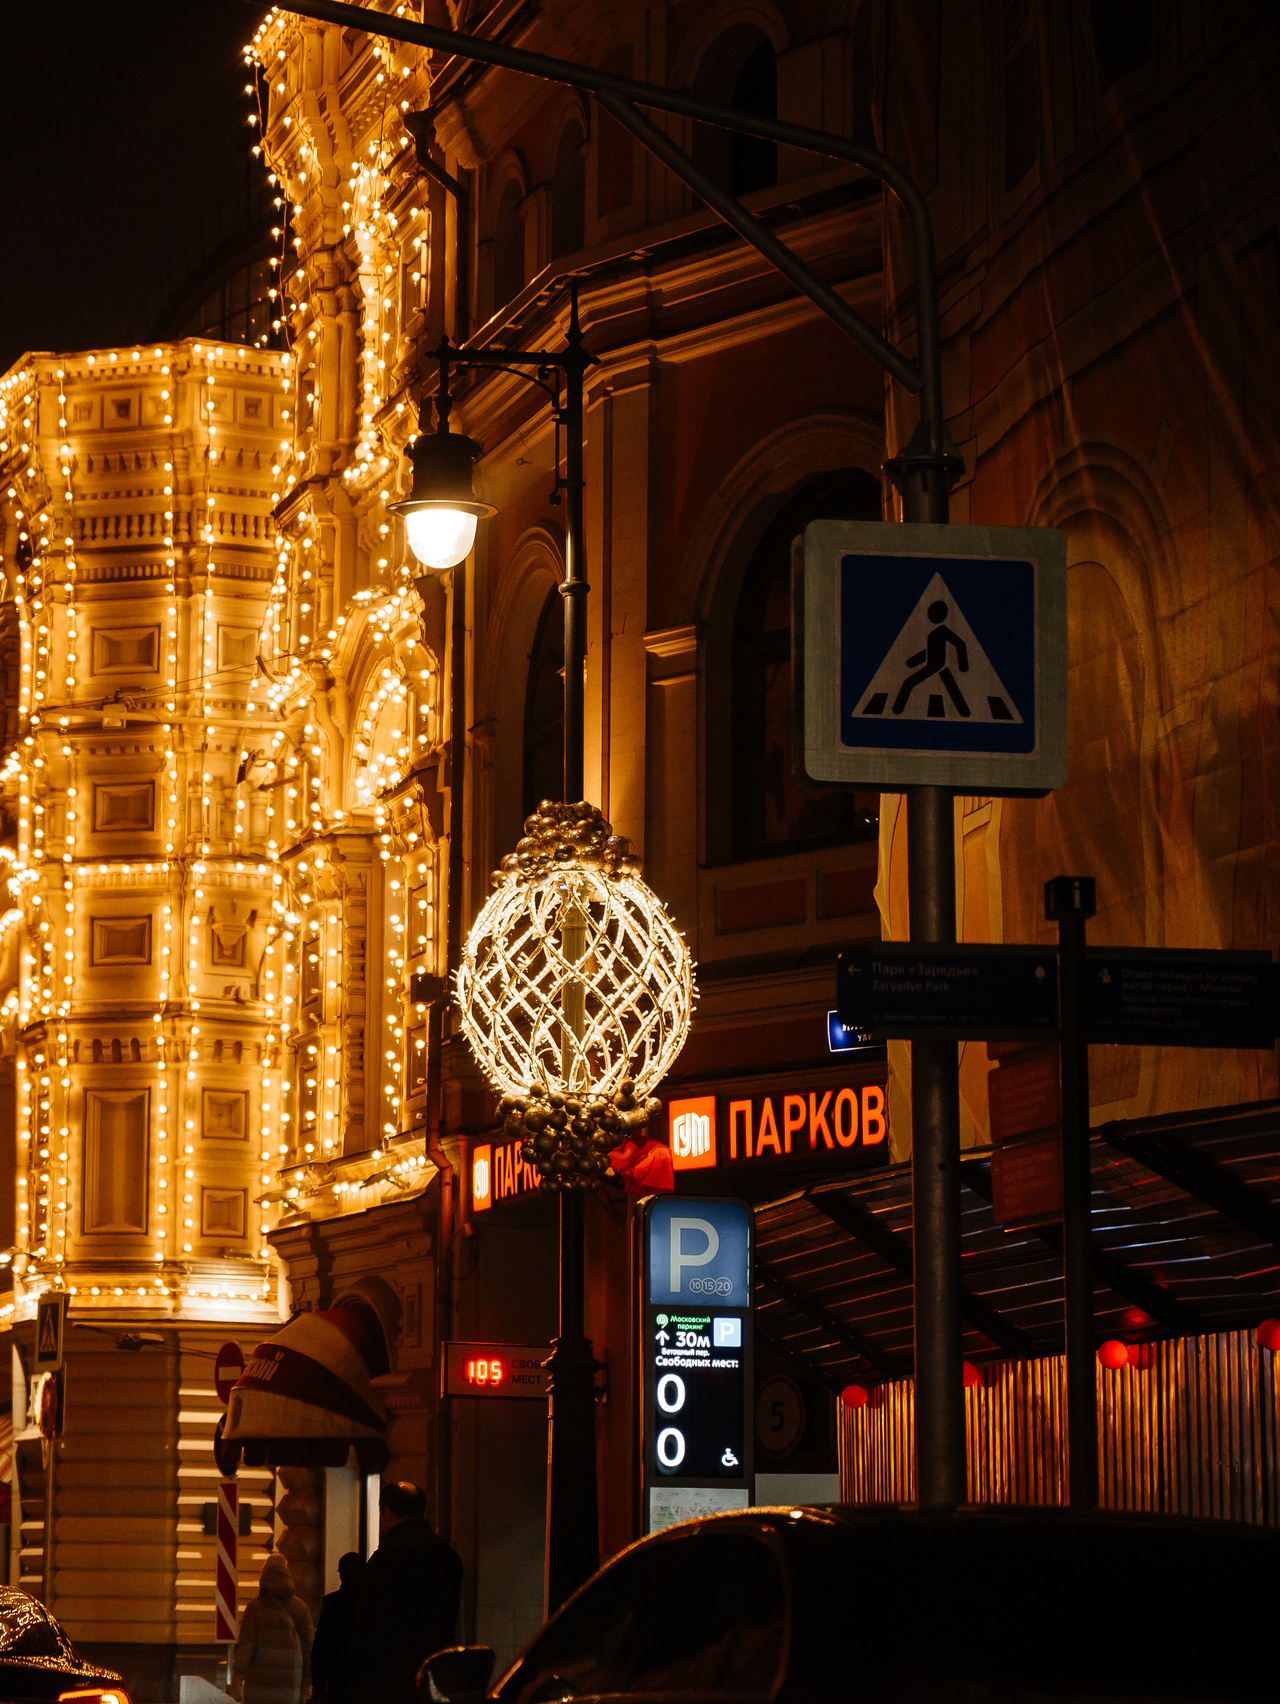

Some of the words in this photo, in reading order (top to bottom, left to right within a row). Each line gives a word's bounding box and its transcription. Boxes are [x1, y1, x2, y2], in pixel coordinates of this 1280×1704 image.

[872, 962, 904, 977] Парк
[909, 963, 979, 977] «Зарядье»
[1122, 968, 1154, 980] Отдел
[1156, 971, 1202, 982] полиции
[1205, 973, 1219, 982] по
[872, 979, 922, 993] Zaryadye
[926, 981, 950, 992] Park
[673, 1112, 711, 1158] ГУМ
[729, 1085, 886, 1160] ПАРКОВ
[670, 1217, 720, 1293] P
[692, 1281, 701, 1290] 10
[703, 1281, 714, 1290] 15
[717, 1281, 731, 1292] 20
[670, 1315, 711, 1324] Московский
[677, 1323, 704, 1331] паркинг
[675, 1331, 711, 1348] 30м
[695, 1349, 710, 1358] пер.
[655, 1355, 711, 1368] Свободных
[712, 1359, 739, 1368] мест:
[468, 1358, 503, 1381] 105
[511, 1374, 542, 1385] МЕСТ
[657, 1373, 686, 1413] 0
[771, 1401, 784, 1432] 5
[657, 1427, 686, 1467] 0
